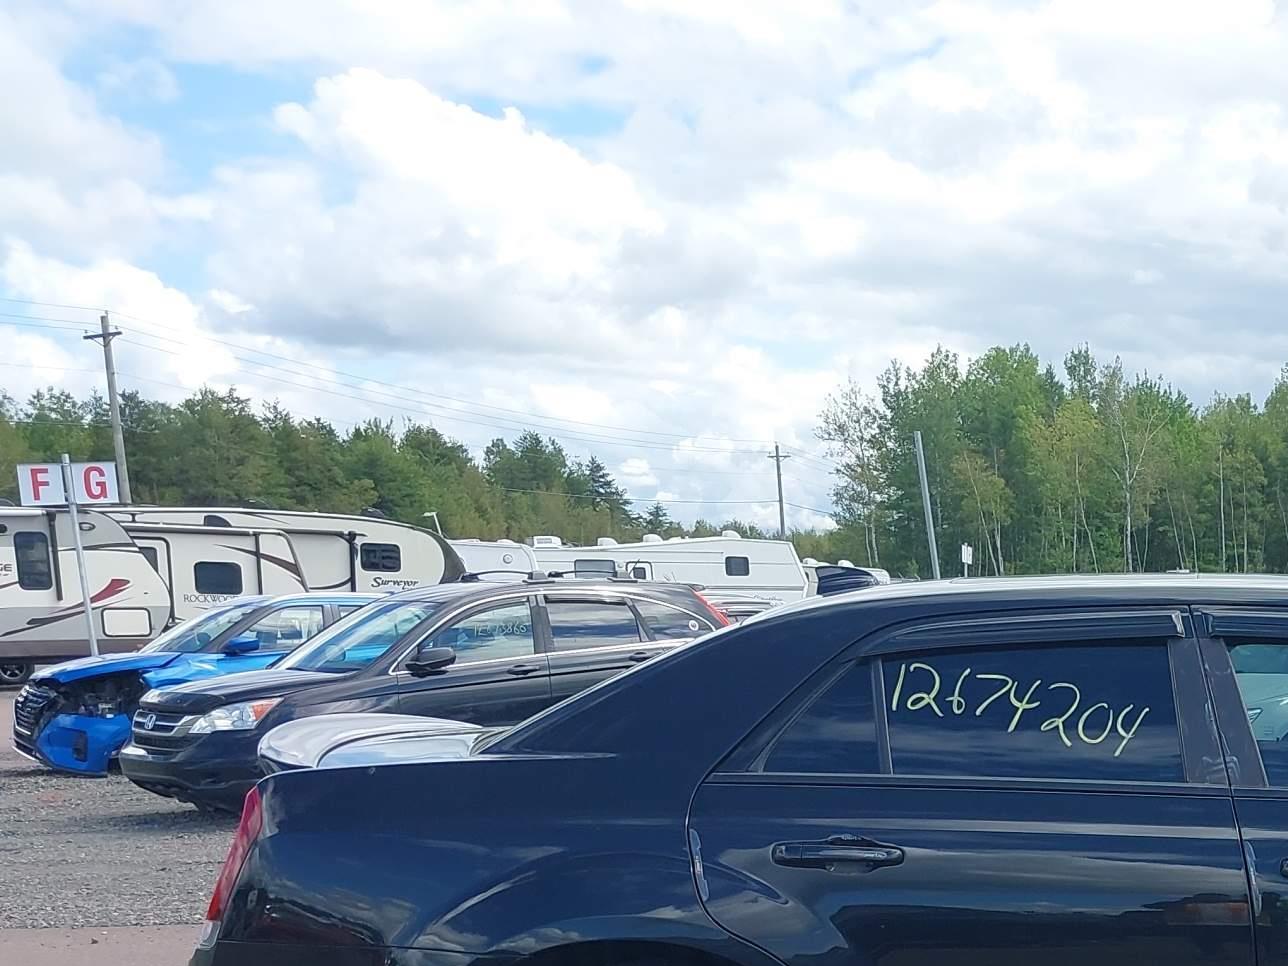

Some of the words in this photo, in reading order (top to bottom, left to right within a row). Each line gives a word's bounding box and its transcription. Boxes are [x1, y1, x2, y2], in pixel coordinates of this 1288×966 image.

[30, 468, 50, 501] F
[83, 465, 108, 500] G
[183, 594, 239, 603] ROCKWOO
[371, 576, 419, 590] Surveyor
[892, 663, 1150, 757] 12674204
